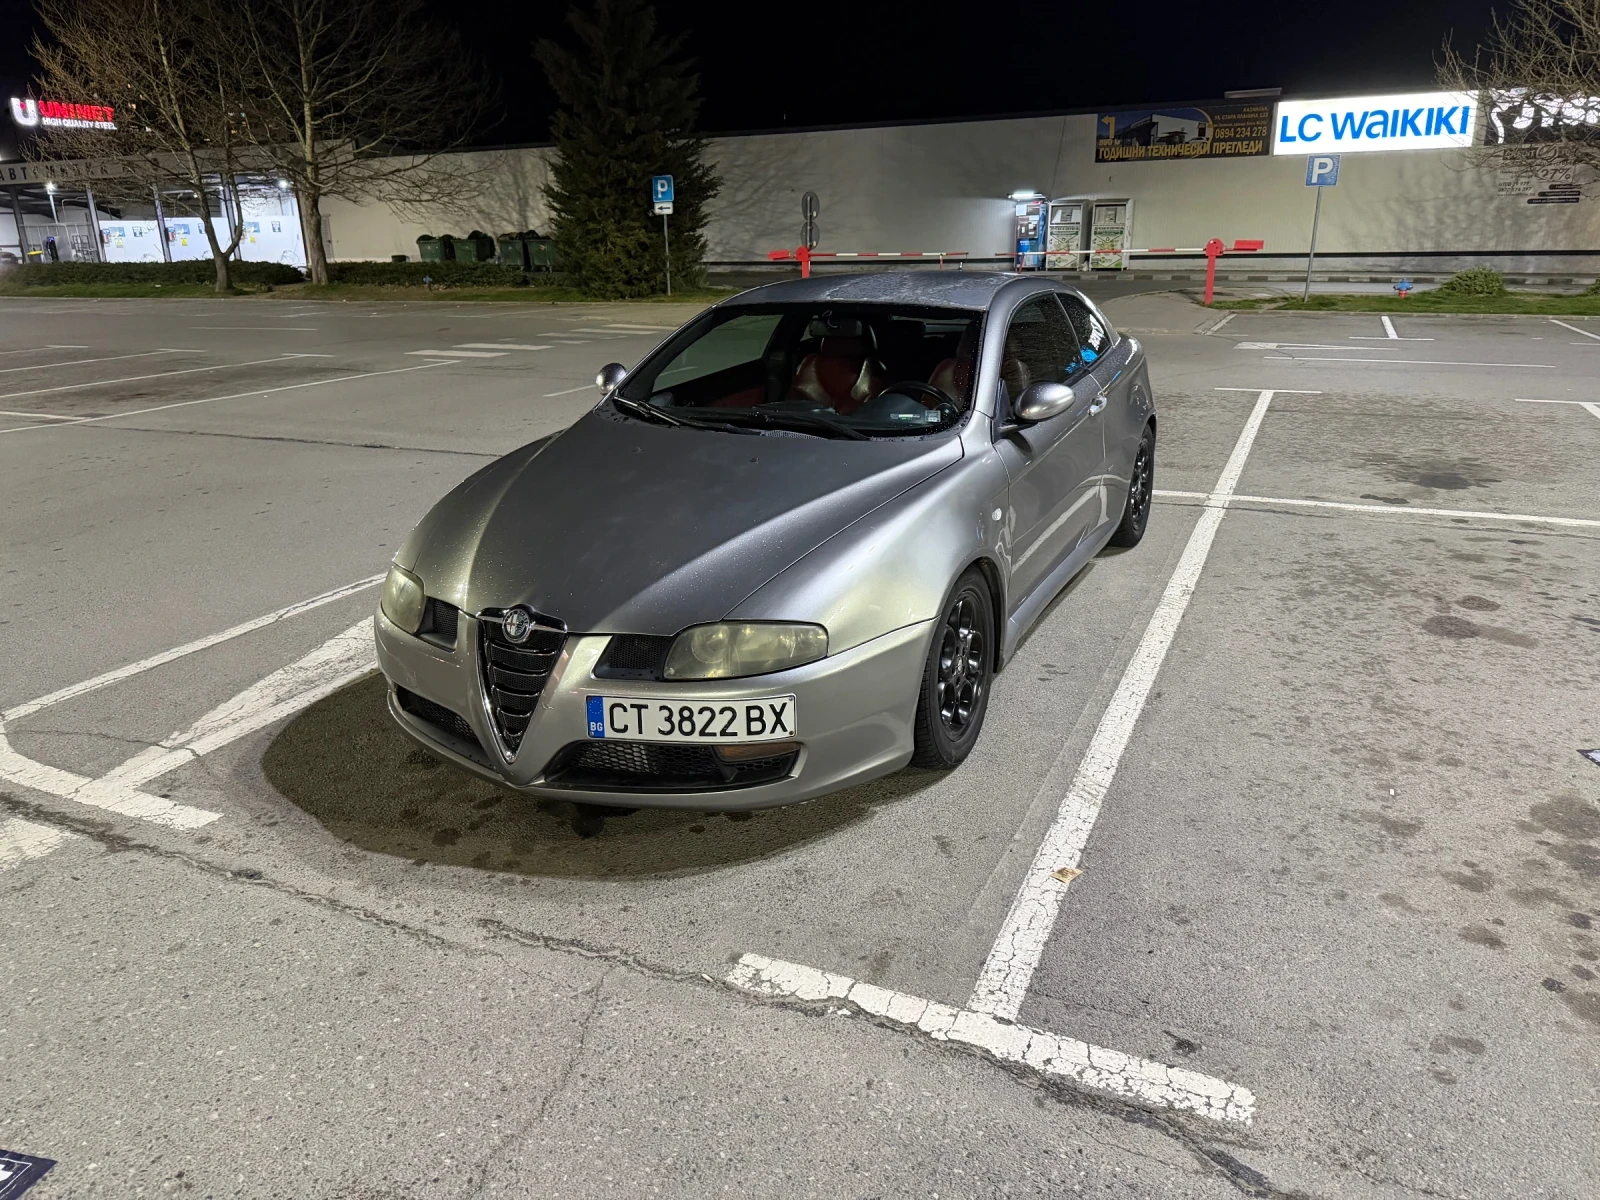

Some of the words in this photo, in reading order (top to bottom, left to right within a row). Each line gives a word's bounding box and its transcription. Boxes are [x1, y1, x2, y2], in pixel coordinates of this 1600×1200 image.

[38, 100, 115, 122] UNIMET
[42, 117, 62, 126] HIGH
[62, 119, 94, 129] QUALITY
[95, 121, 118, 130] STEEL
[1214, 128, 1235, 139] 0894
[1235, 127, 1251, 138] 234
[1252, 126, 1268, 137] 278
[1279, 113, 1324, 143] LC
[1099, 145, 1146, 161] ГОДИШНИ
[1147, 141, 1211, 158] ТЕХНИЧЕСКИ
[1212, 140, 1264, 155] ПРЕГЛЕДИ
[1311, 157, 1334, 184] P
[657, 179, 668, 198] P
[590, 722, 603, 732] BG
[609, 702, 649, 735] CT
[657, 705, 738, 737] 3822
[746, 702, 788, 737] BX
